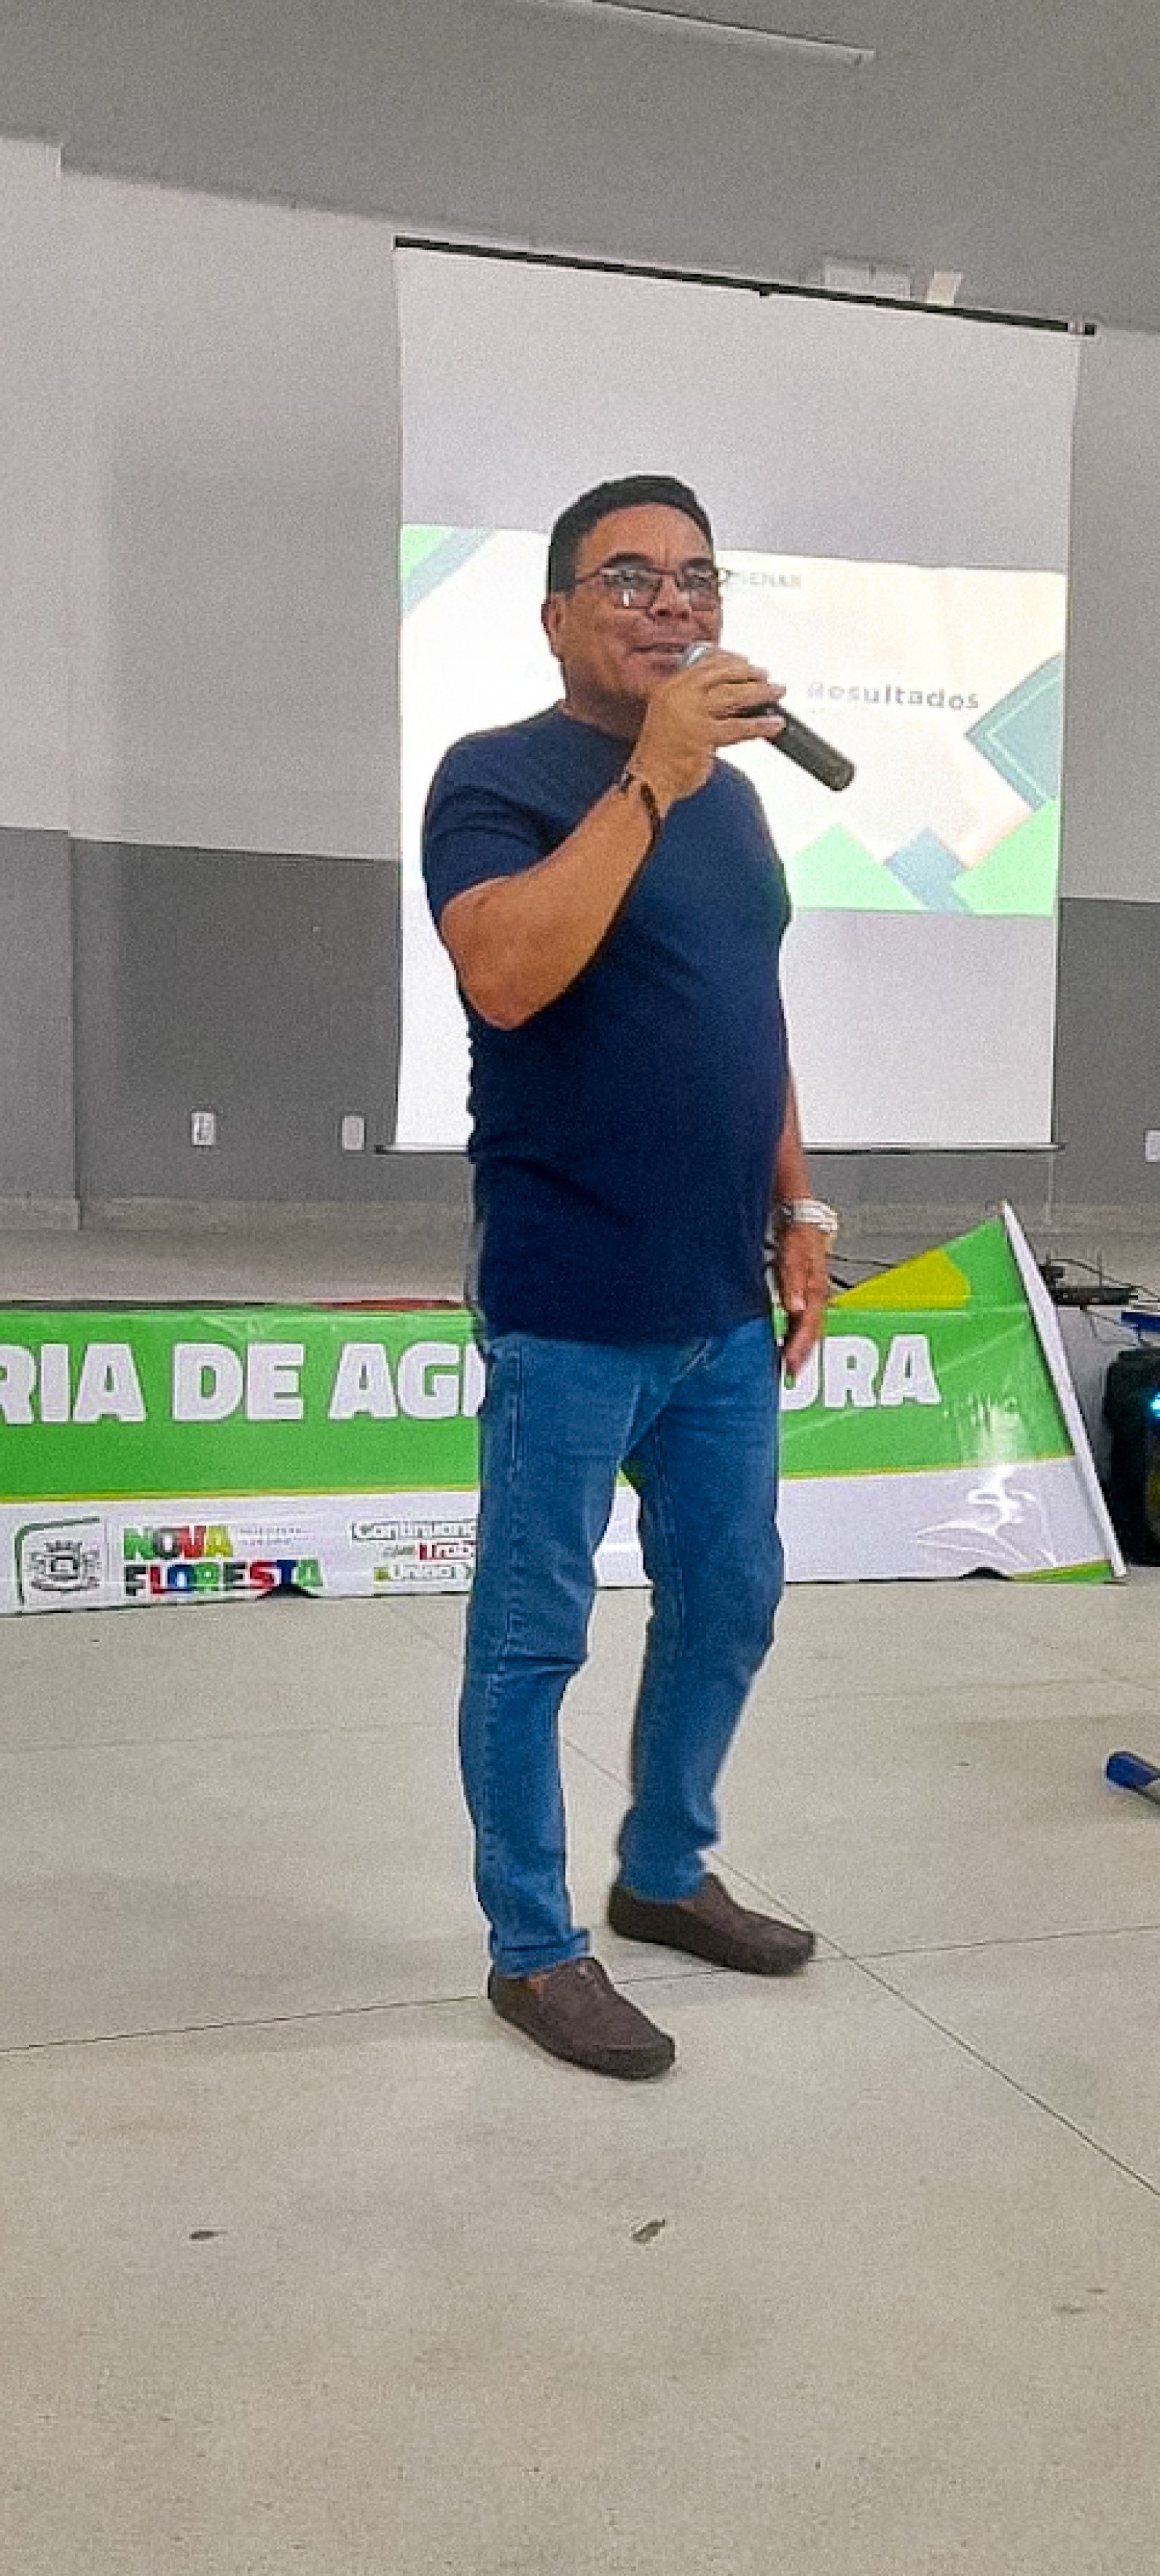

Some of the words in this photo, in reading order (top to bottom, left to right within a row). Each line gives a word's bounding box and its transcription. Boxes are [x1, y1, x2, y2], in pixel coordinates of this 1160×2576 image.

[807, 682, 980, 711] Resultados
[172, 1343, 305, 1420] DE
[123, 1525, 234, 1561] NOVA
[124, 1559, 324, 1597] FLORESTA
